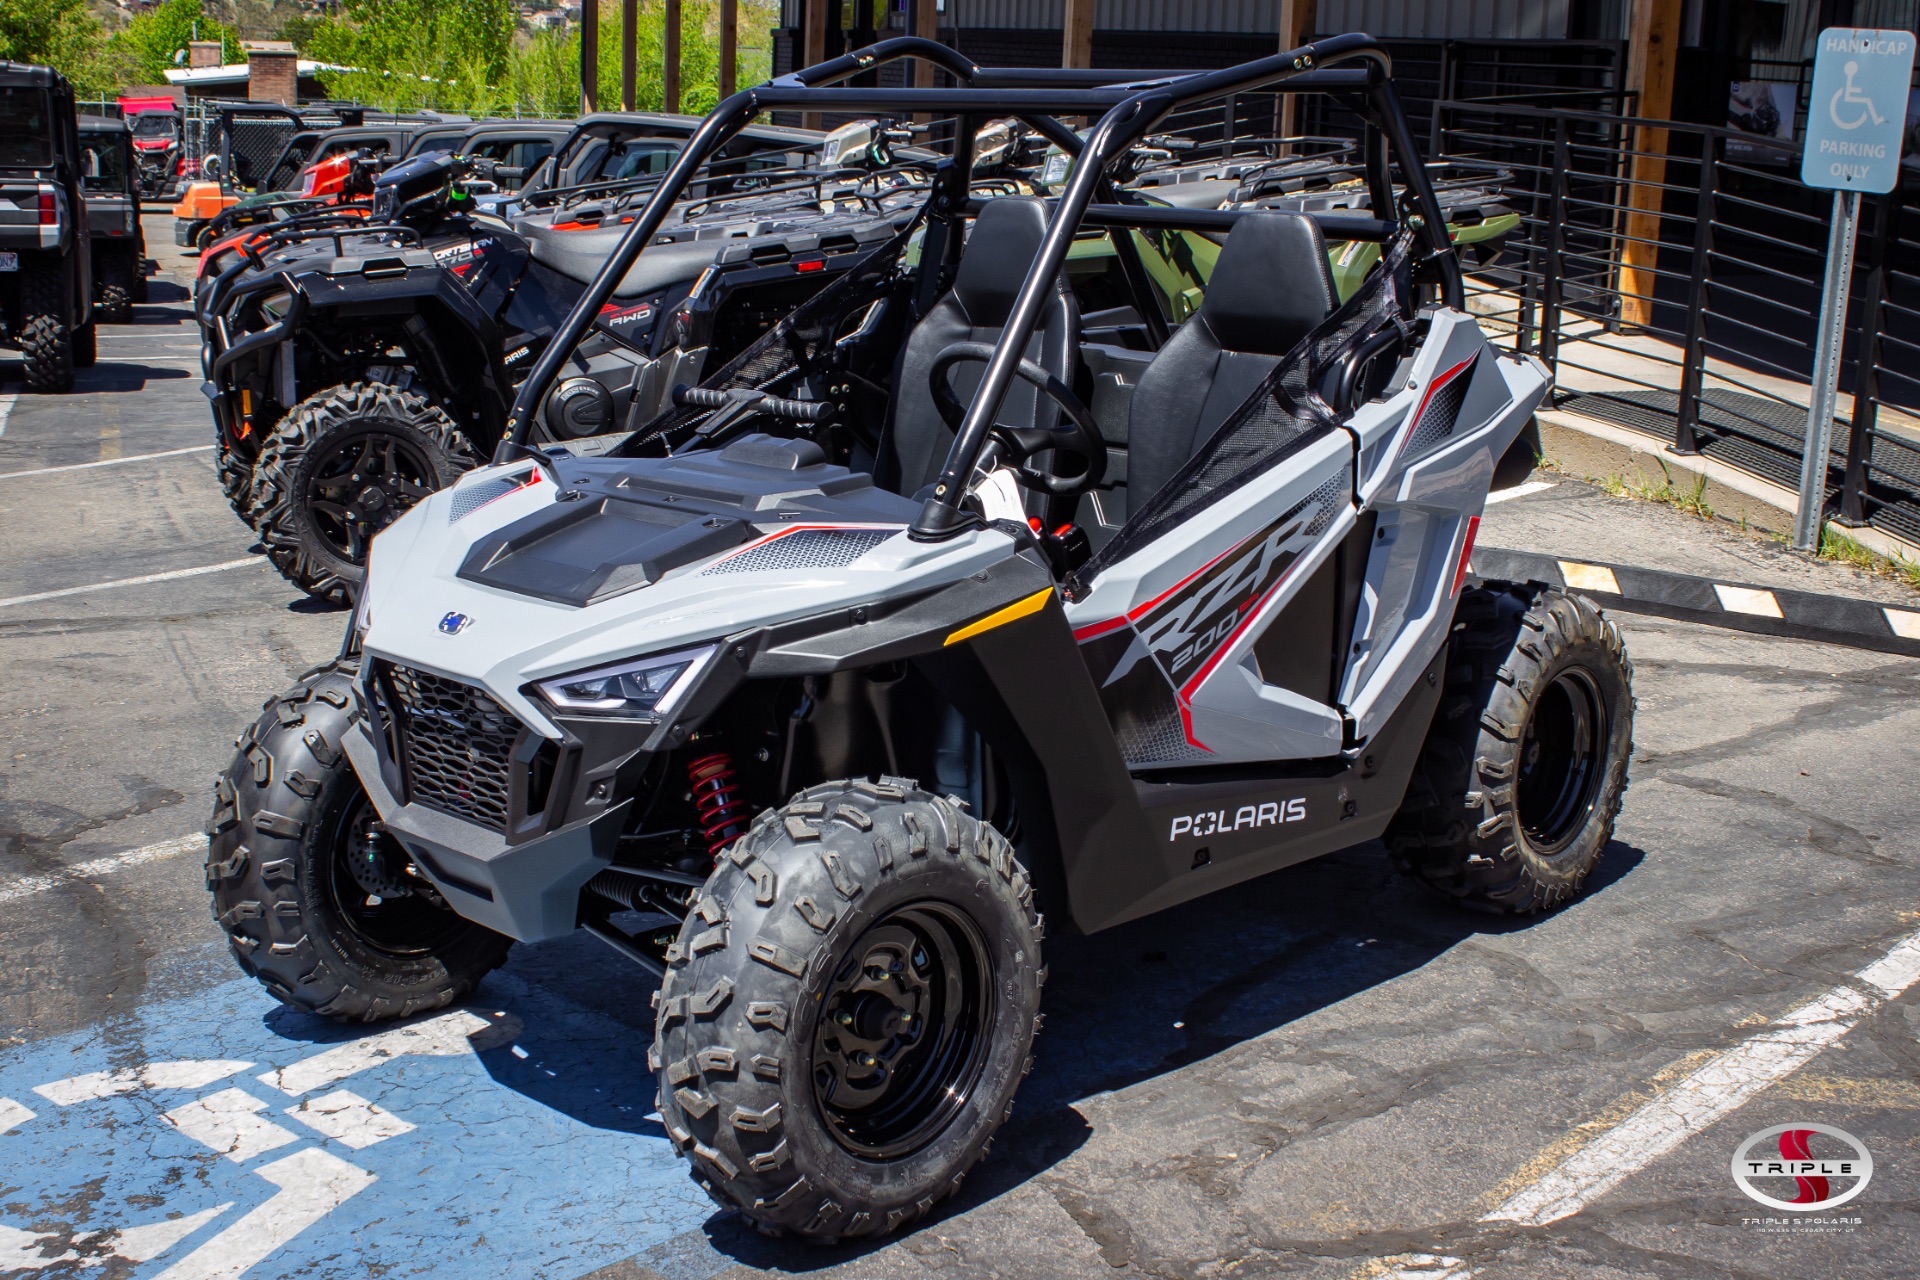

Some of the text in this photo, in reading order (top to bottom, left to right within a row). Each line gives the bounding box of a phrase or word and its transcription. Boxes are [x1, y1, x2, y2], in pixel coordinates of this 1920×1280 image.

[1826, 38, 1908, 56] HANDICAP
[1819, 139, 1886, 159] PARKING
[1830, 162, 1870, 179] ONLY
[609, 309, 651, 327] AWD
[1101, 501, 1326, 689] RZR
[1171, 608, 1238, 675] 200
[1169, 797, 1307, 842] POLARIS
